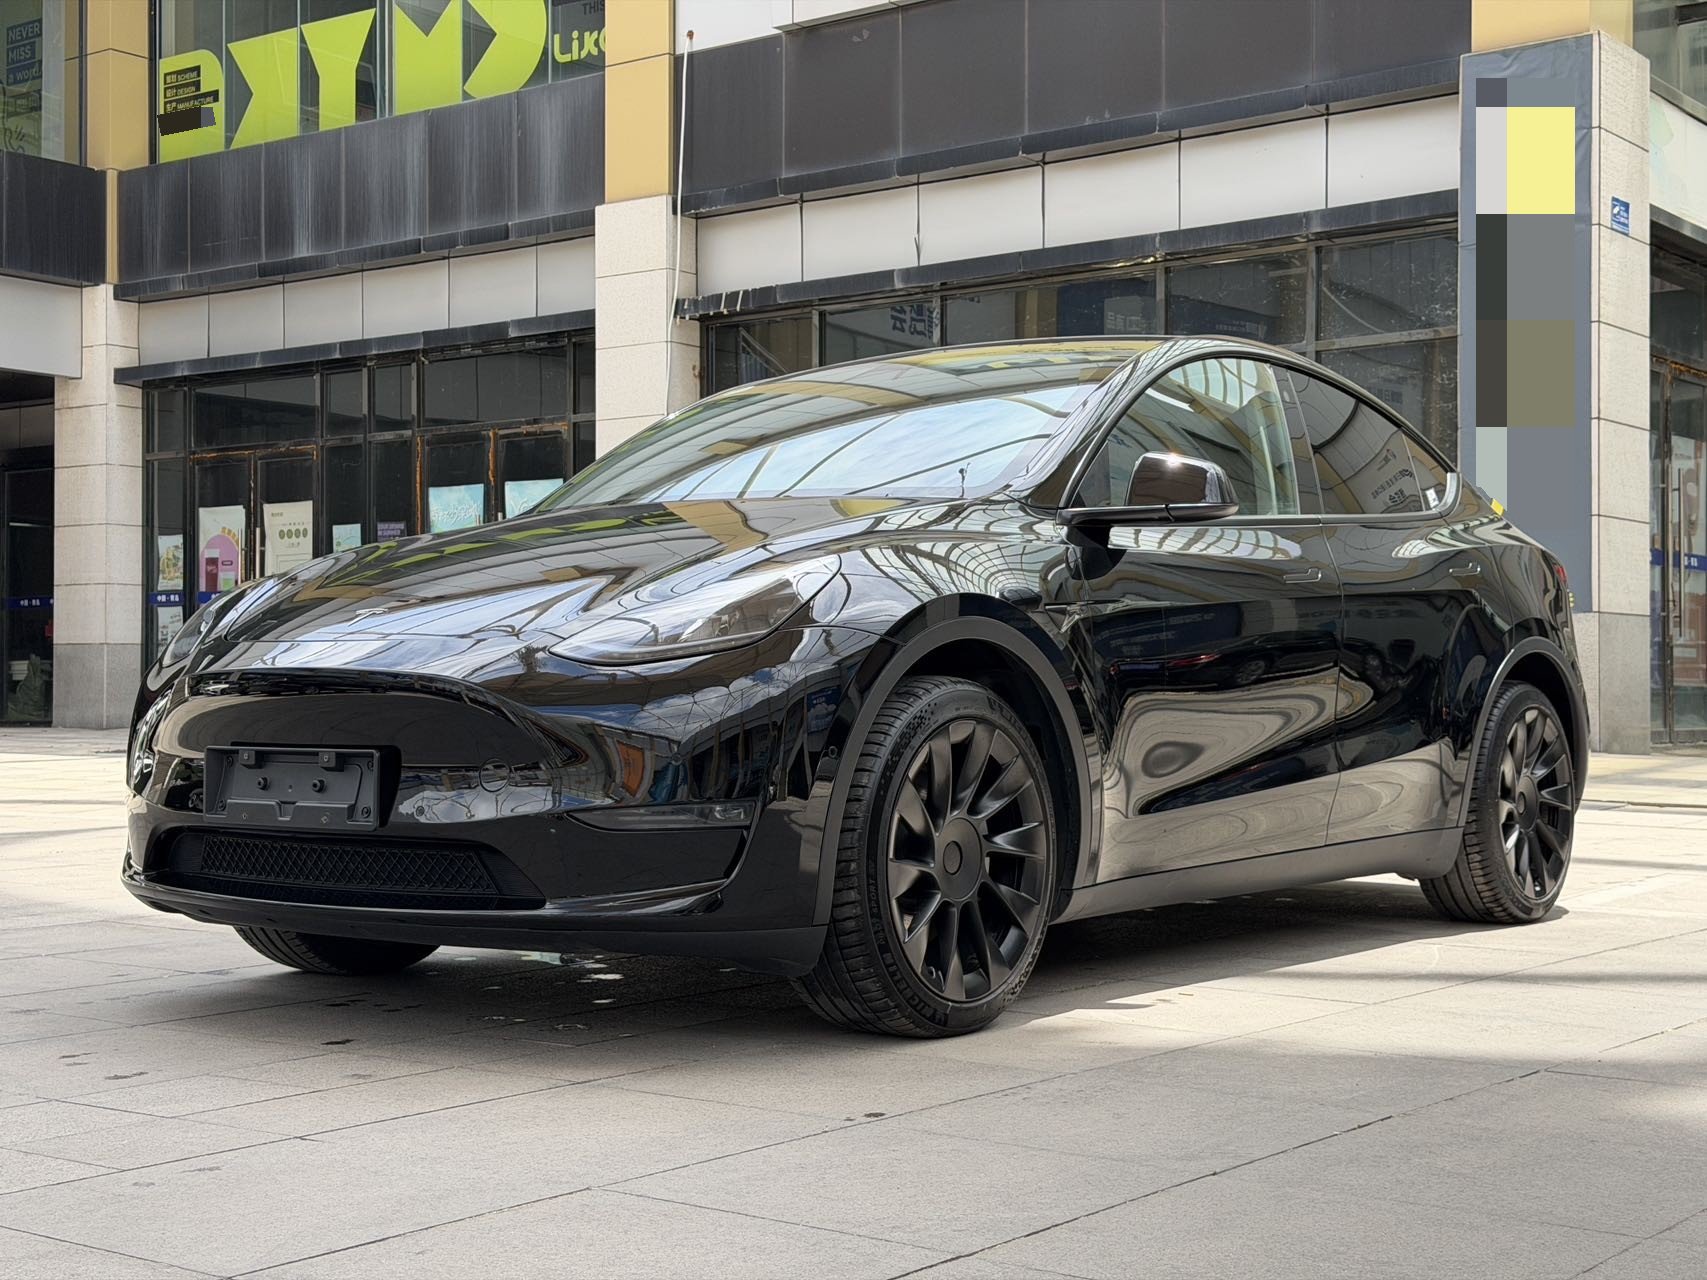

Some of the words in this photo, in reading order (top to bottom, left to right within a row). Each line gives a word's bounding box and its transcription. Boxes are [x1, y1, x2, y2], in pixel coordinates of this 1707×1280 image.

[8, 23, 40, 41] NEVER
[8, 45, 31, 63] MISS
[178, 71, 198, 82] SCHEME
[177, 86, 196, 96] DESIGN
[177, 96, 214, 109] MANUFACTURE
